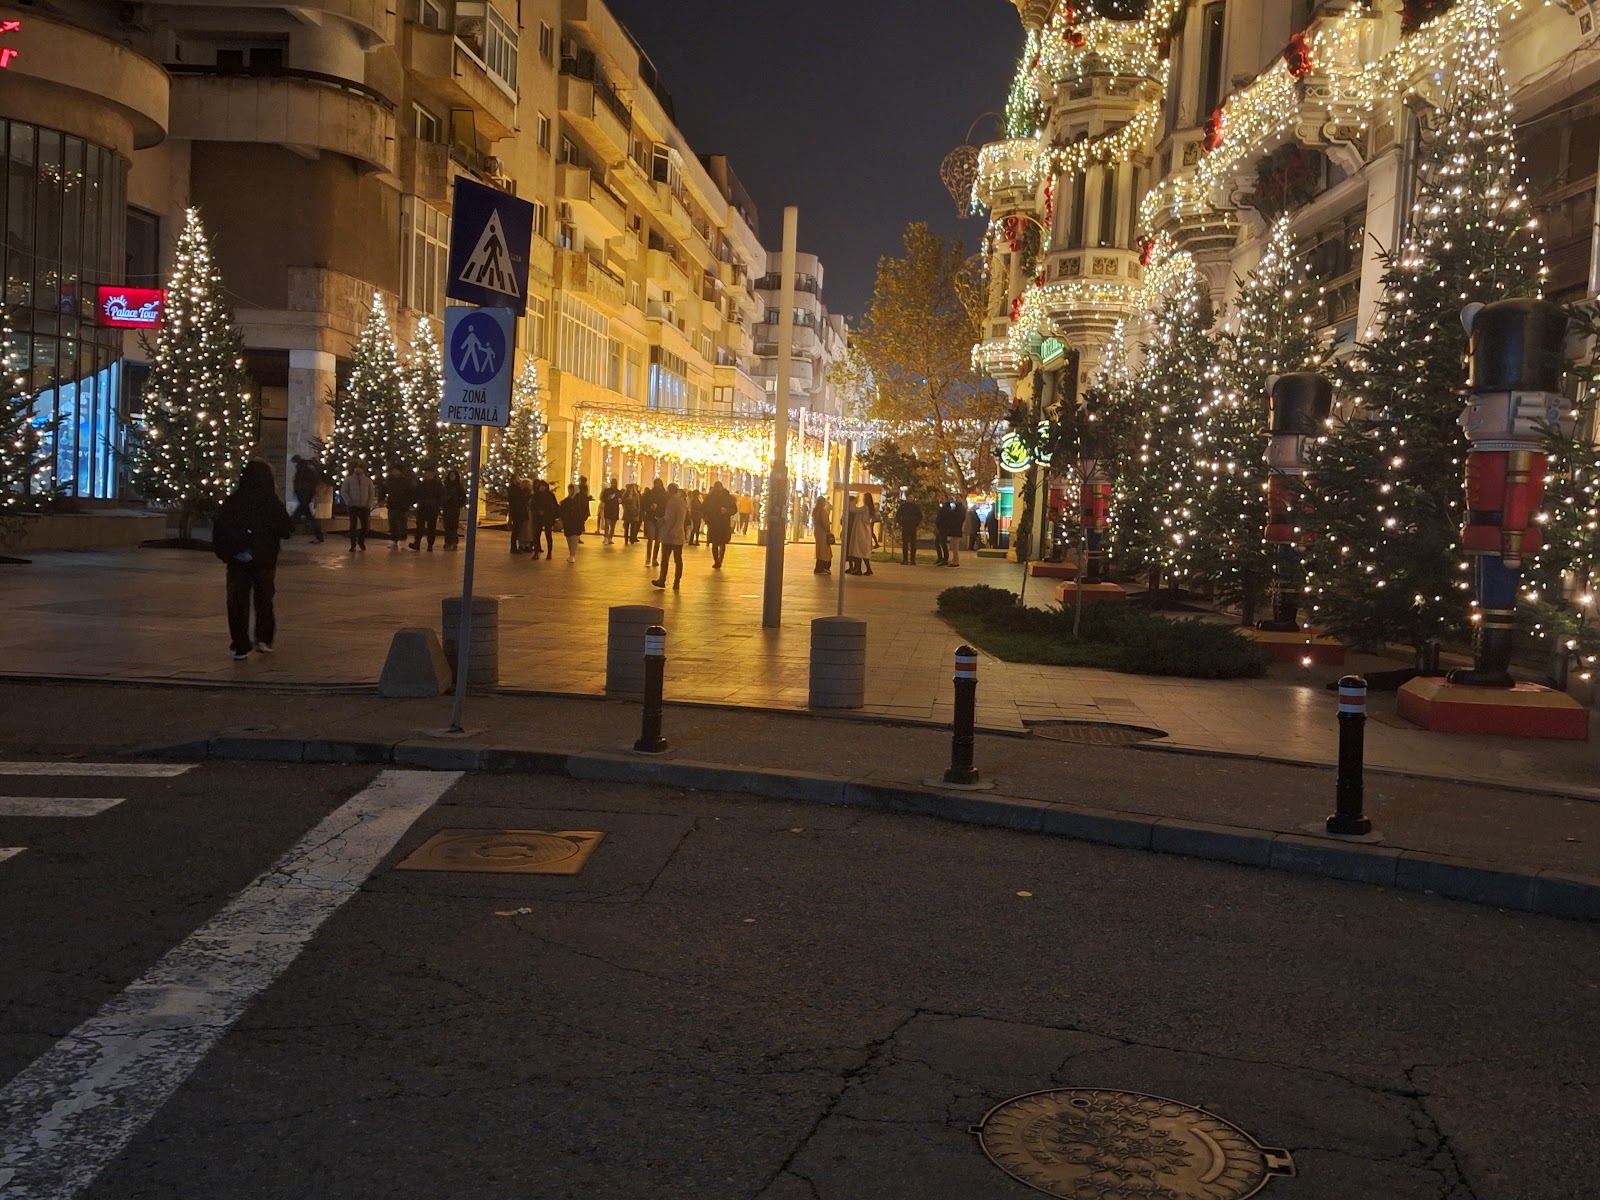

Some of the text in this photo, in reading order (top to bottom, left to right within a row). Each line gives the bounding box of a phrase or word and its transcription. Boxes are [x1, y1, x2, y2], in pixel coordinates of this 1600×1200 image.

[110, 304, 159, 319] Palace Tour
[462, 388, 487, 404] ZONĂ
